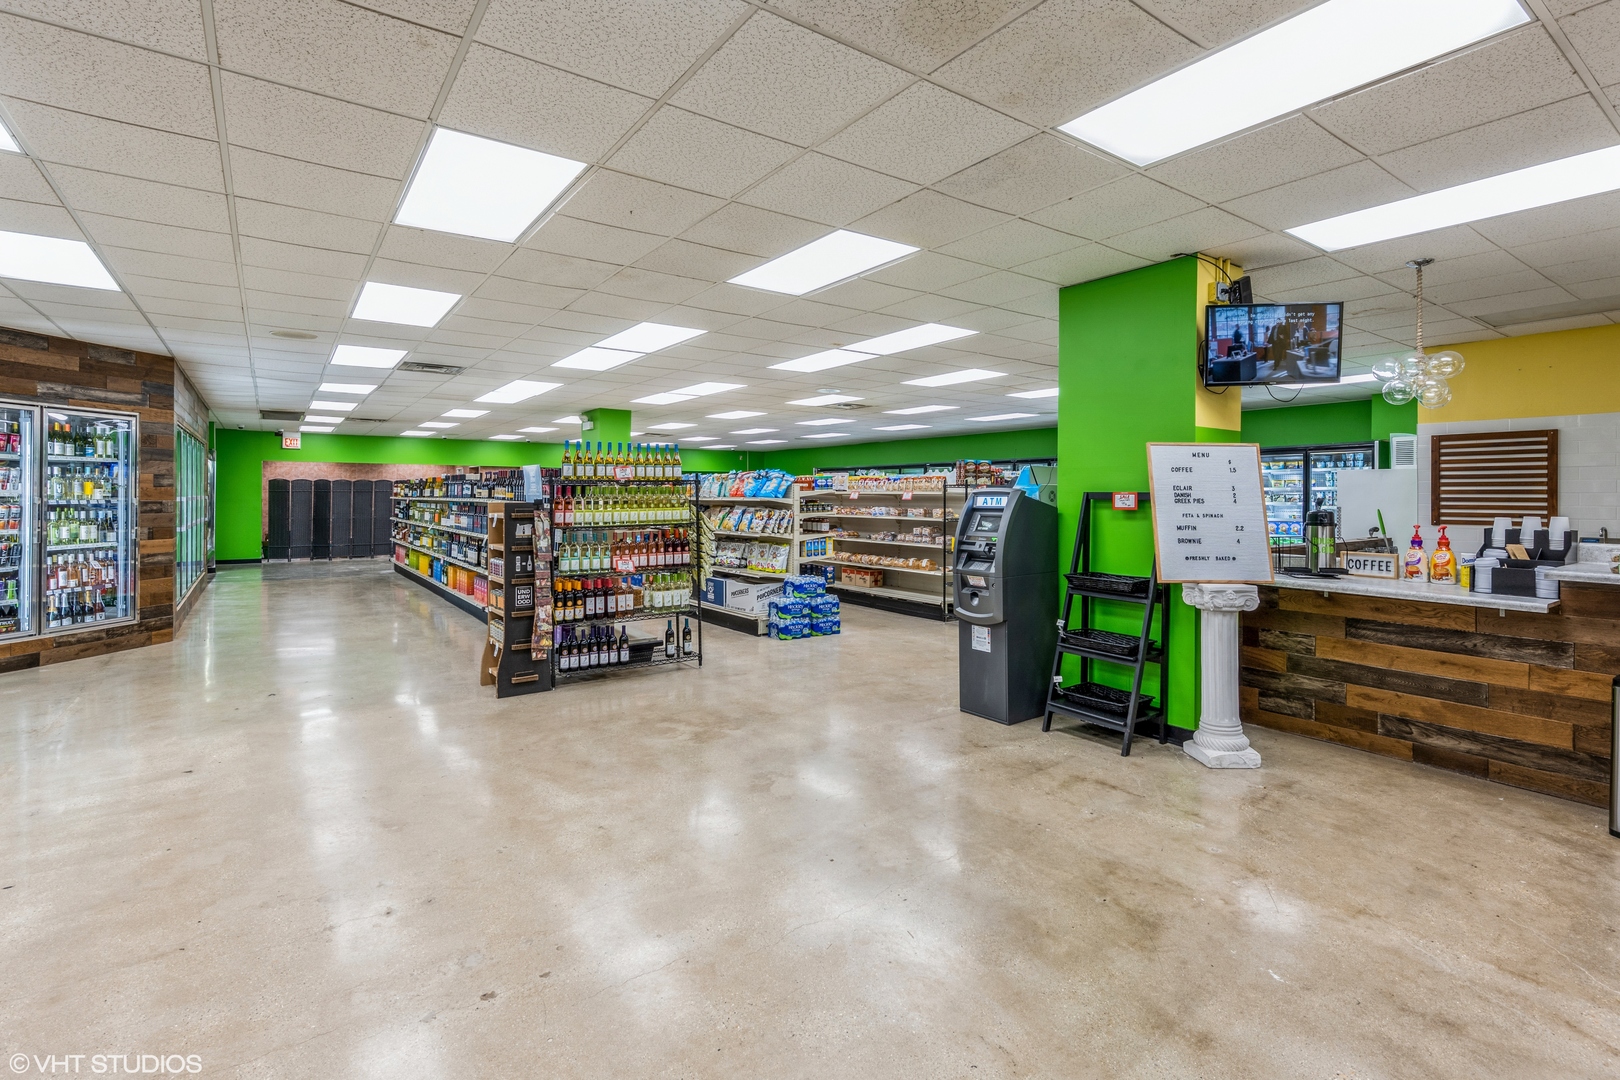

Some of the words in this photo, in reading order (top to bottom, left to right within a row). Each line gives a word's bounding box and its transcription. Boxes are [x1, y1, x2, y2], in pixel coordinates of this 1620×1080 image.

[284, 437, 298, 447] EXIT
[982, 497, 1002, 506] ATM
[1347, 558, 1392, 572] COFFEE
